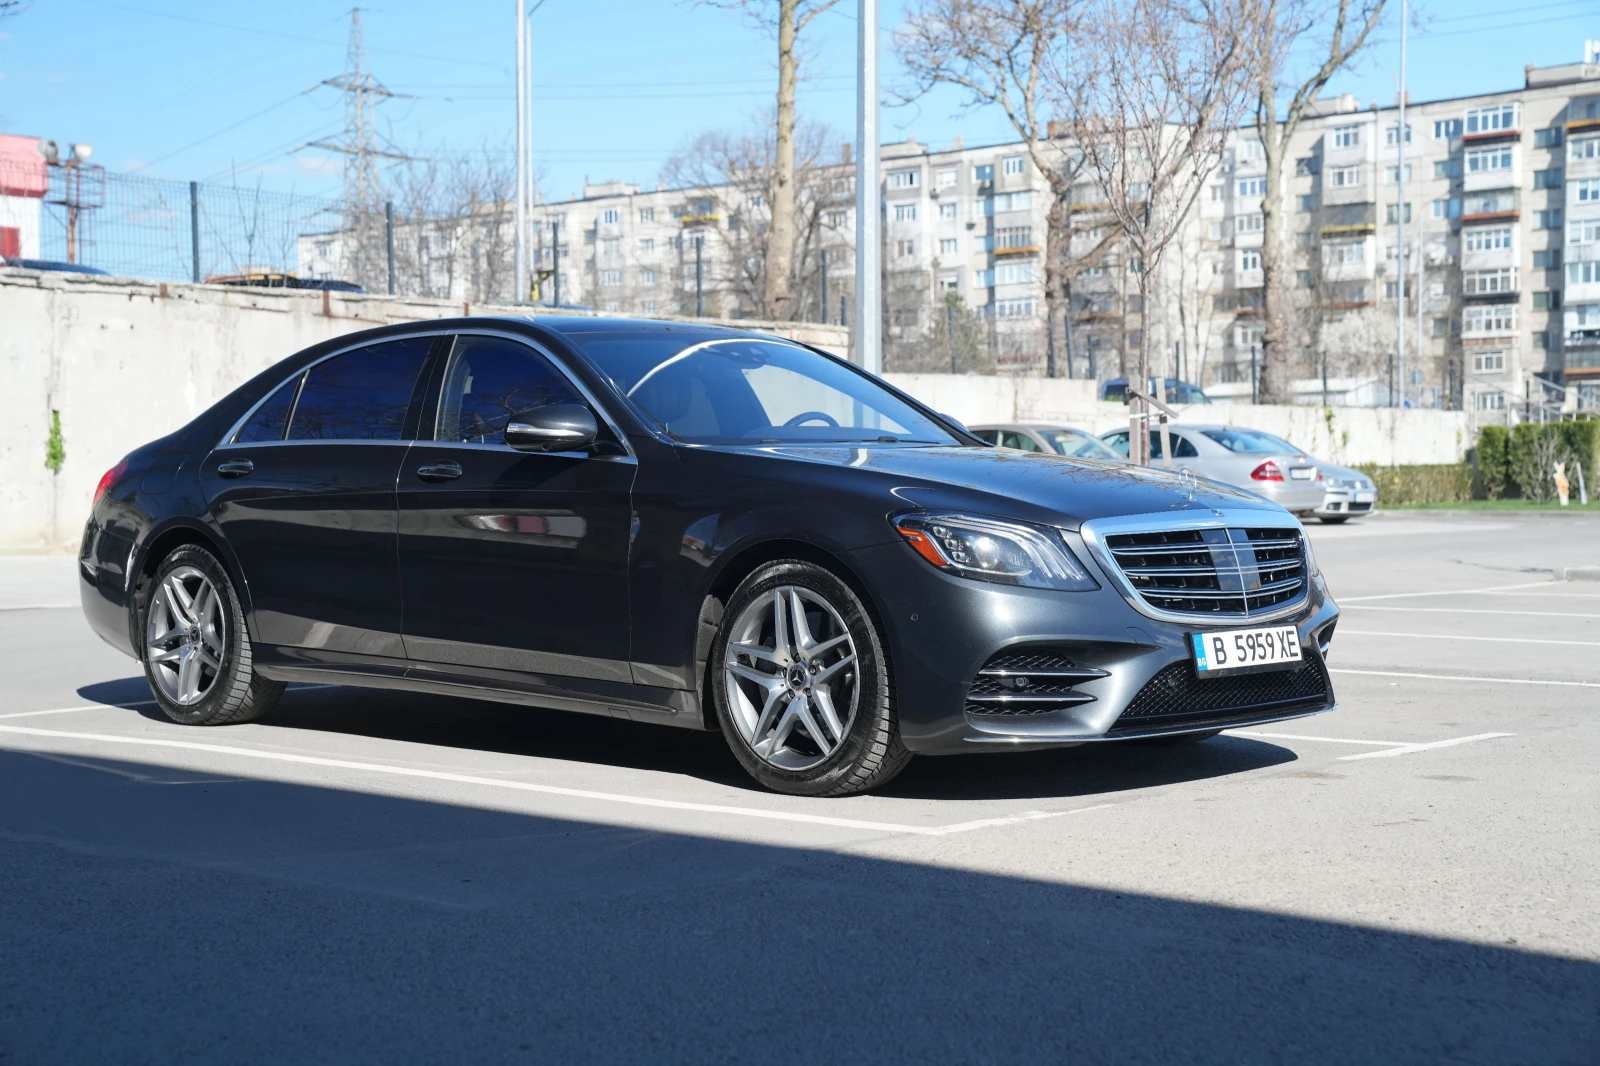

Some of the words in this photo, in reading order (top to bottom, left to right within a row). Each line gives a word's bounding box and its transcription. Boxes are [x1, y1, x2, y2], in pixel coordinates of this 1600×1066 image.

[1213, 637, 1227, 665] B
[1234, 632, 1275, 662] 5959
[1276, 630, 1299, 659] XE
[1197, 657, 1207, 667] BG
